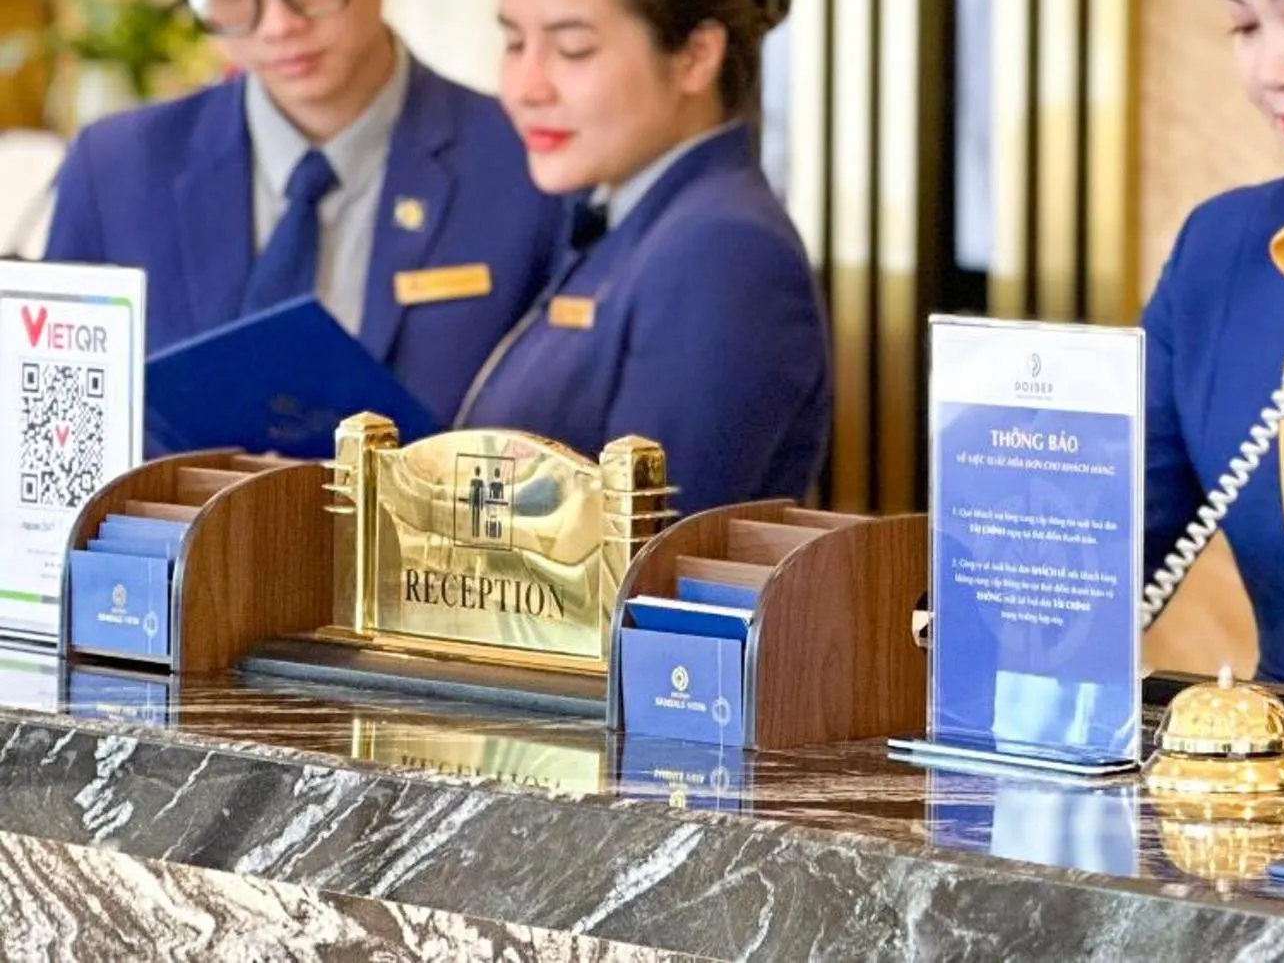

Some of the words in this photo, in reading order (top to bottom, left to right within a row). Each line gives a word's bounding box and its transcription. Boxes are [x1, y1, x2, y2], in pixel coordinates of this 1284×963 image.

[21, 305, 107, 353] VIETQR
[990, 426, 1044, 451] THÔNG
[404, 568, 566, 620] RECEPTION
